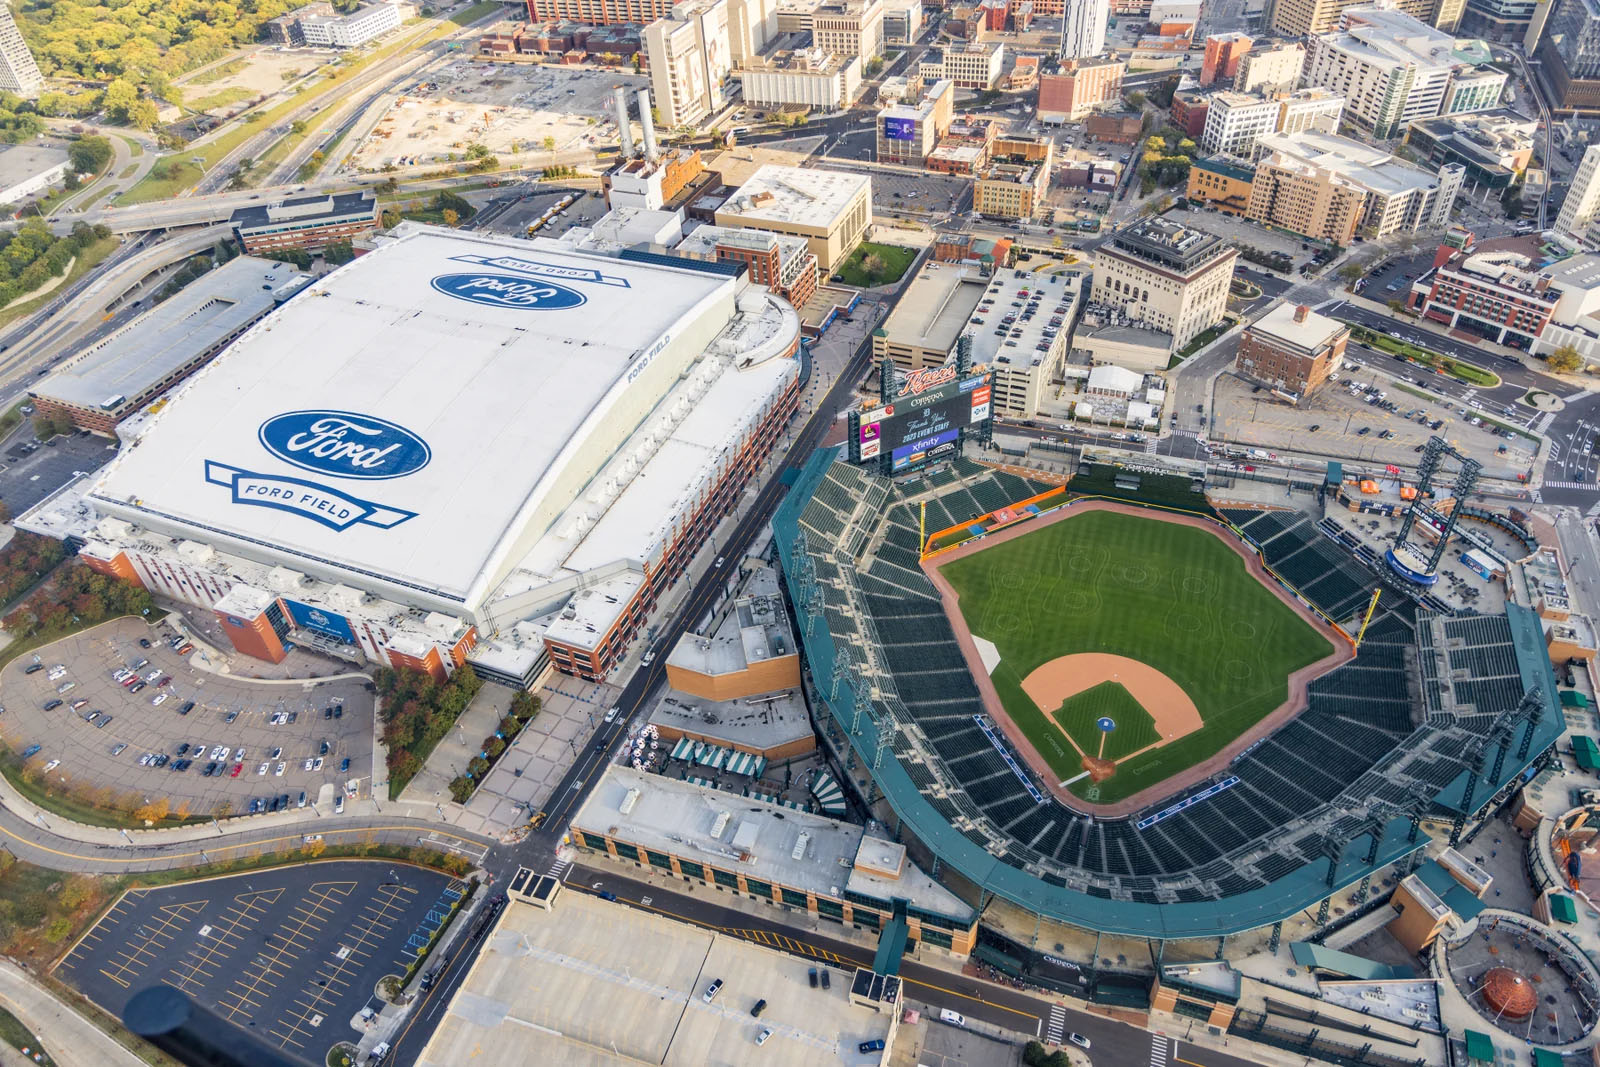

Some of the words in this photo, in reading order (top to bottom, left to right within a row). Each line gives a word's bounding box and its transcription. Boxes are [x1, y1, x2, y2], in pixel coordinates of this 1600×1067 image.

[499, 260, 540, 271] FIELD
[546, 267, 589, 277] FORD
[456, 277, 558, 305] Ford
[628, 357, 649, 384] FORD
[649, 335, 670, 361] FIELD
[898, 364, 957, 396] Tigers
[907, 420, 929, 433] Thank
[916, 426, 934, 438] EVENT
[934, 421, 950, 432] STAFF
[287, 418, 403, 469] Ford
[912, 436, 940, 452] xfinity
[245, 485, 293, 500] FORD
[300, 494, 350, 519] FIELD
[1411, 506, 1434, 523] BELFOR
